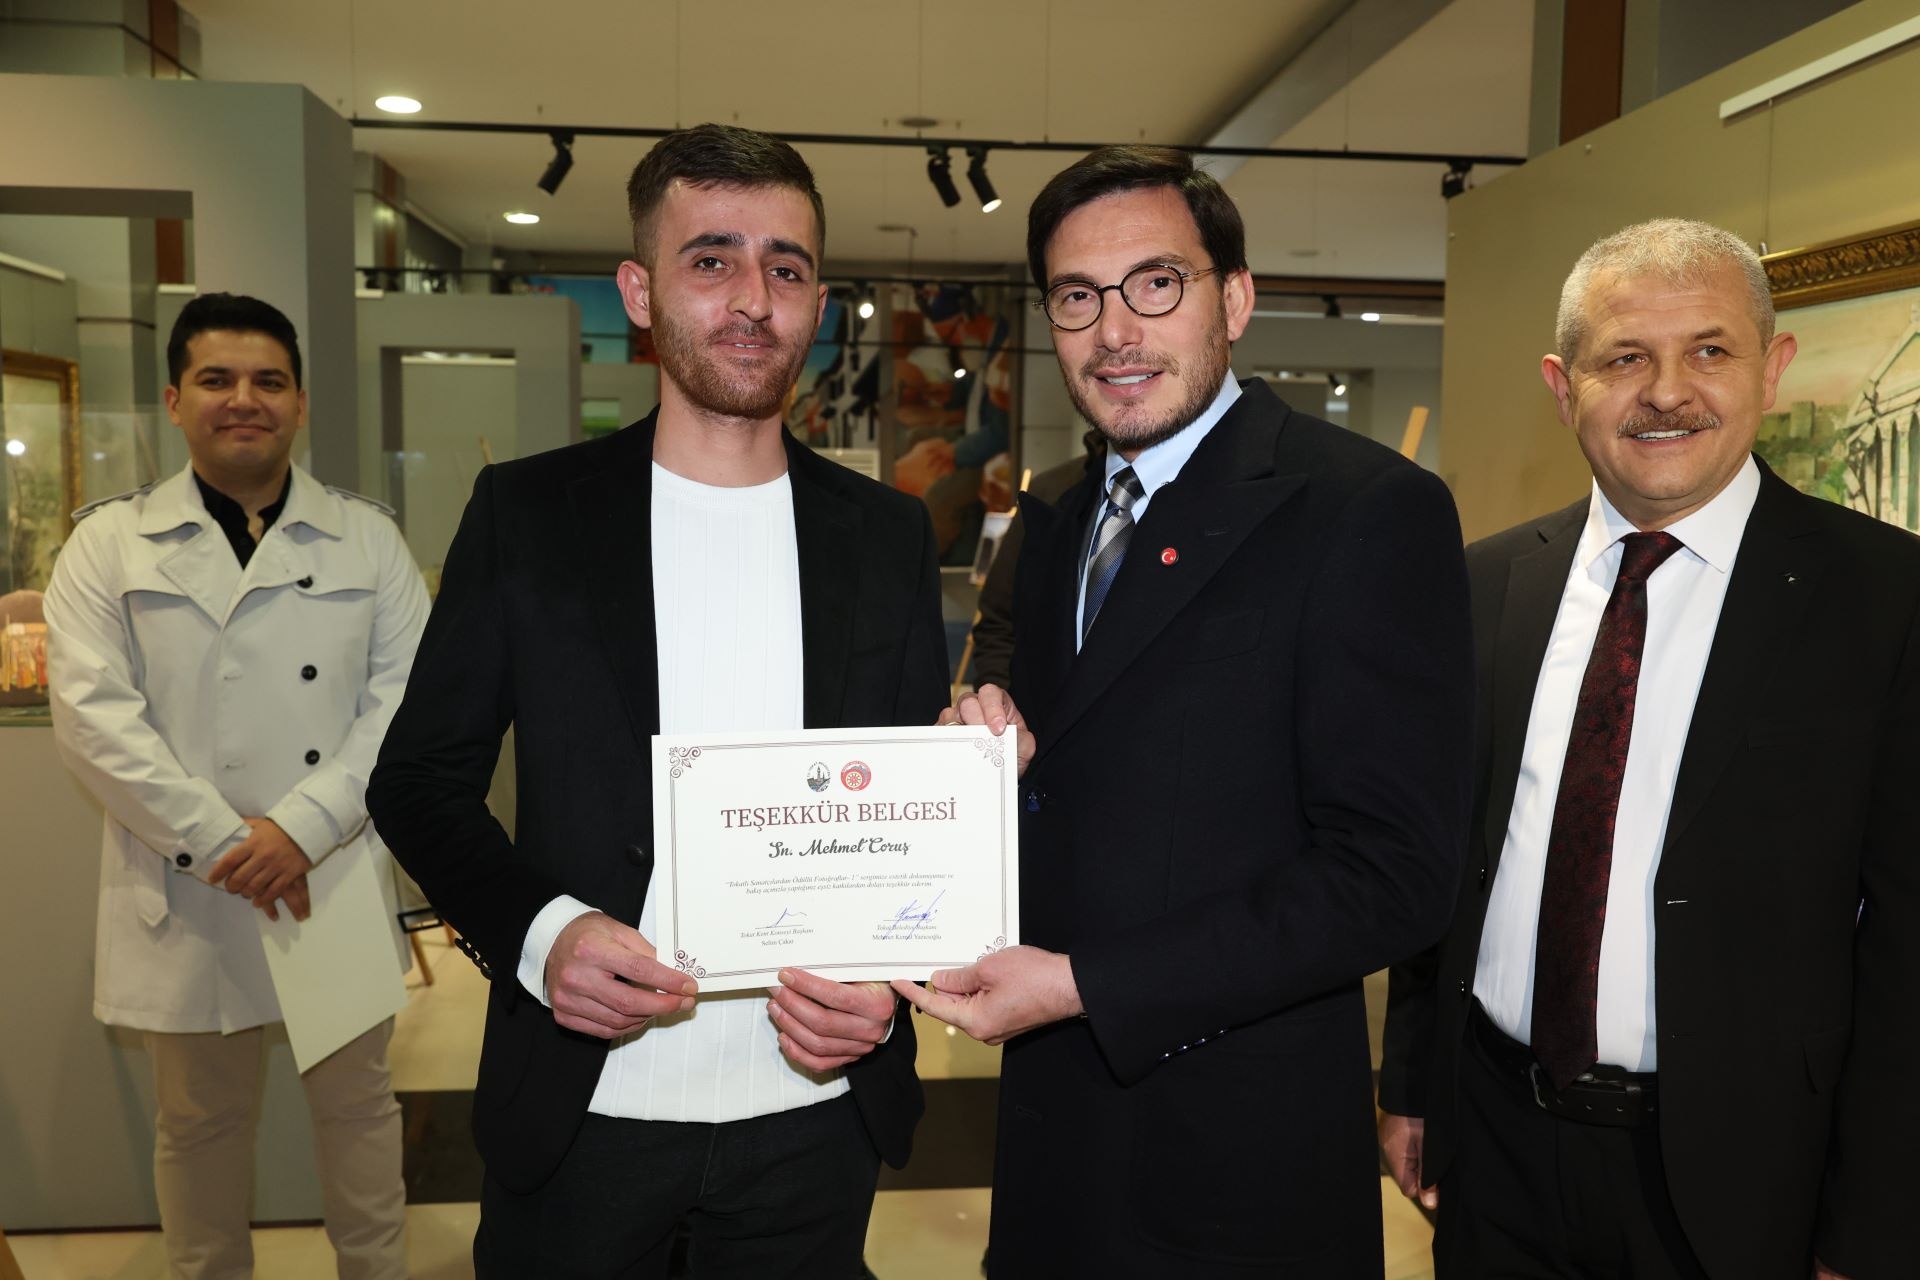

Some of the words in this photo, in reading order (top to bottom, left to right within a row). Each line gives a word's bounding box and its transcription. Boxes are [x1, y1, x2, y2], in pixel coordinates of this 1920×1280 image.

[720, 800, 850, 832] TEŞEKKÜR
[857, 797, 957, 822] BELGESİ
[799, 837, 868, 857] Mehmet
[868, 837, 911, 855] Coruş
